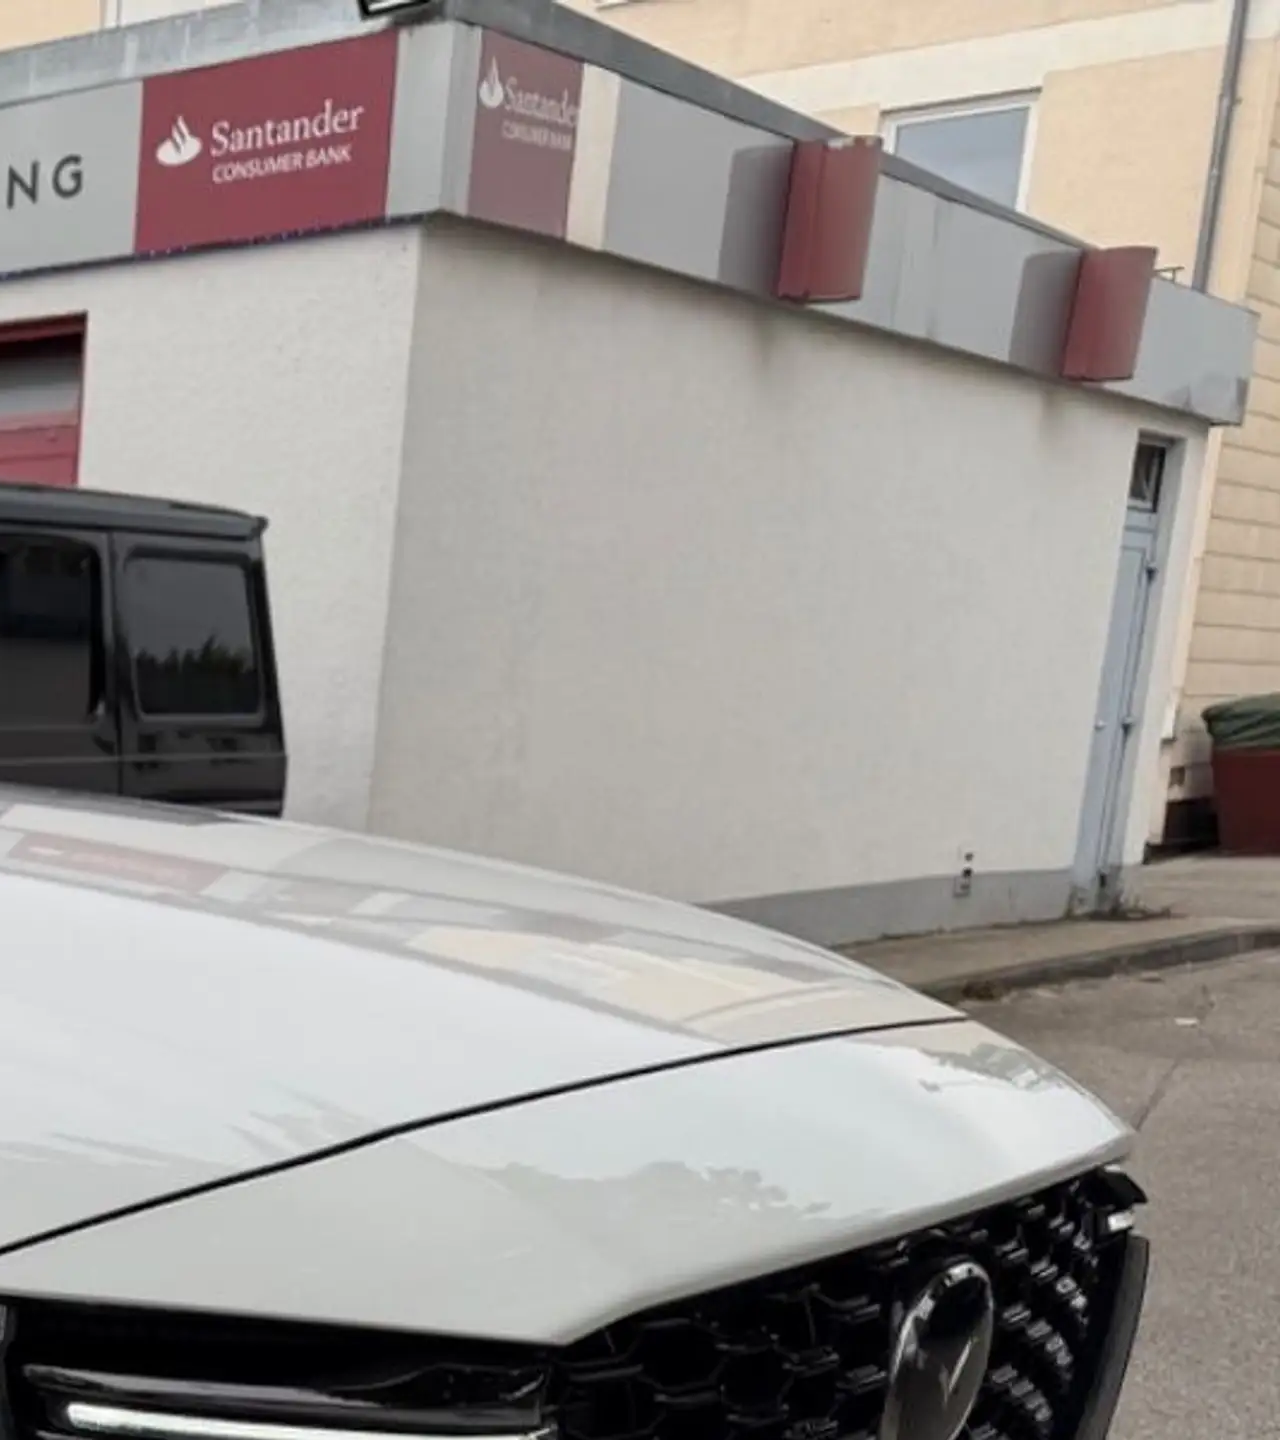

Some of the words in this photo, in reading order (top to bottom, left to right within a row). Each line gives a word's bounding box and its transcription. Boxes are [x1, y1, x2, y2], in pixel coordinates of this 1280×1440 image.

[209, 98, 365, 157] Santander
[212, 151, 304, 185] CONSUMER
[305, 144, 353, 169] BANK
